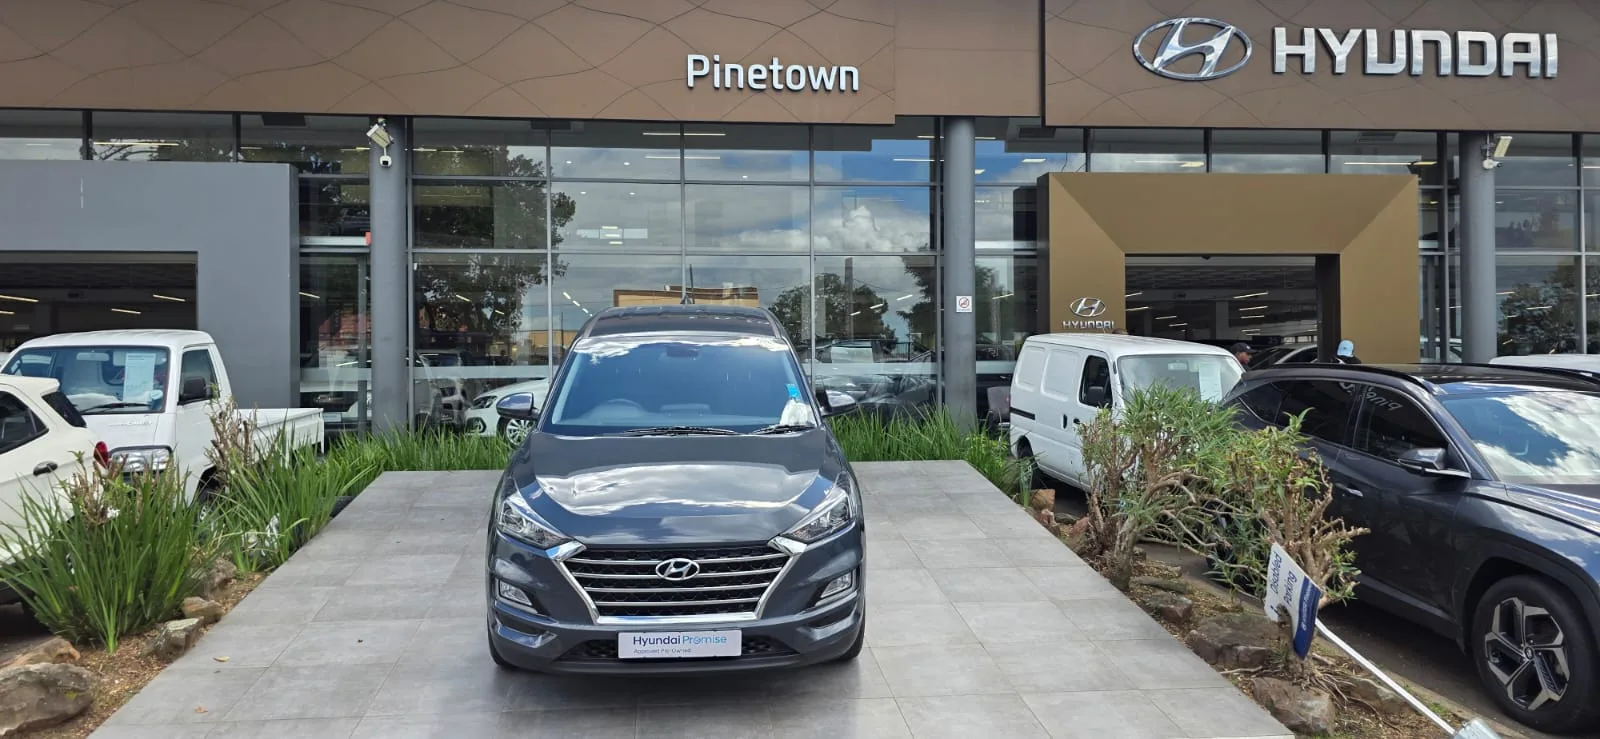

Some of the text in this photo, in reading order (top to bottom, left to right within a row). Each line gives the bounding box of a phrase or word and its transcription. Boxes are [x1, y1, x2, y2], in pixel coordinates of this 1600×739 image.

[1273, 26, 1558, 78] HYUNDAI
[687, 54, 860, 92] Pinetown
[1062, 320, 1115, 329] HYUNDAI
[1270, 551, 1282, 594] Disabled
[1283, 570, 1297, 606] Parking
[633, 635, 727, 647] Hyundai Promise
